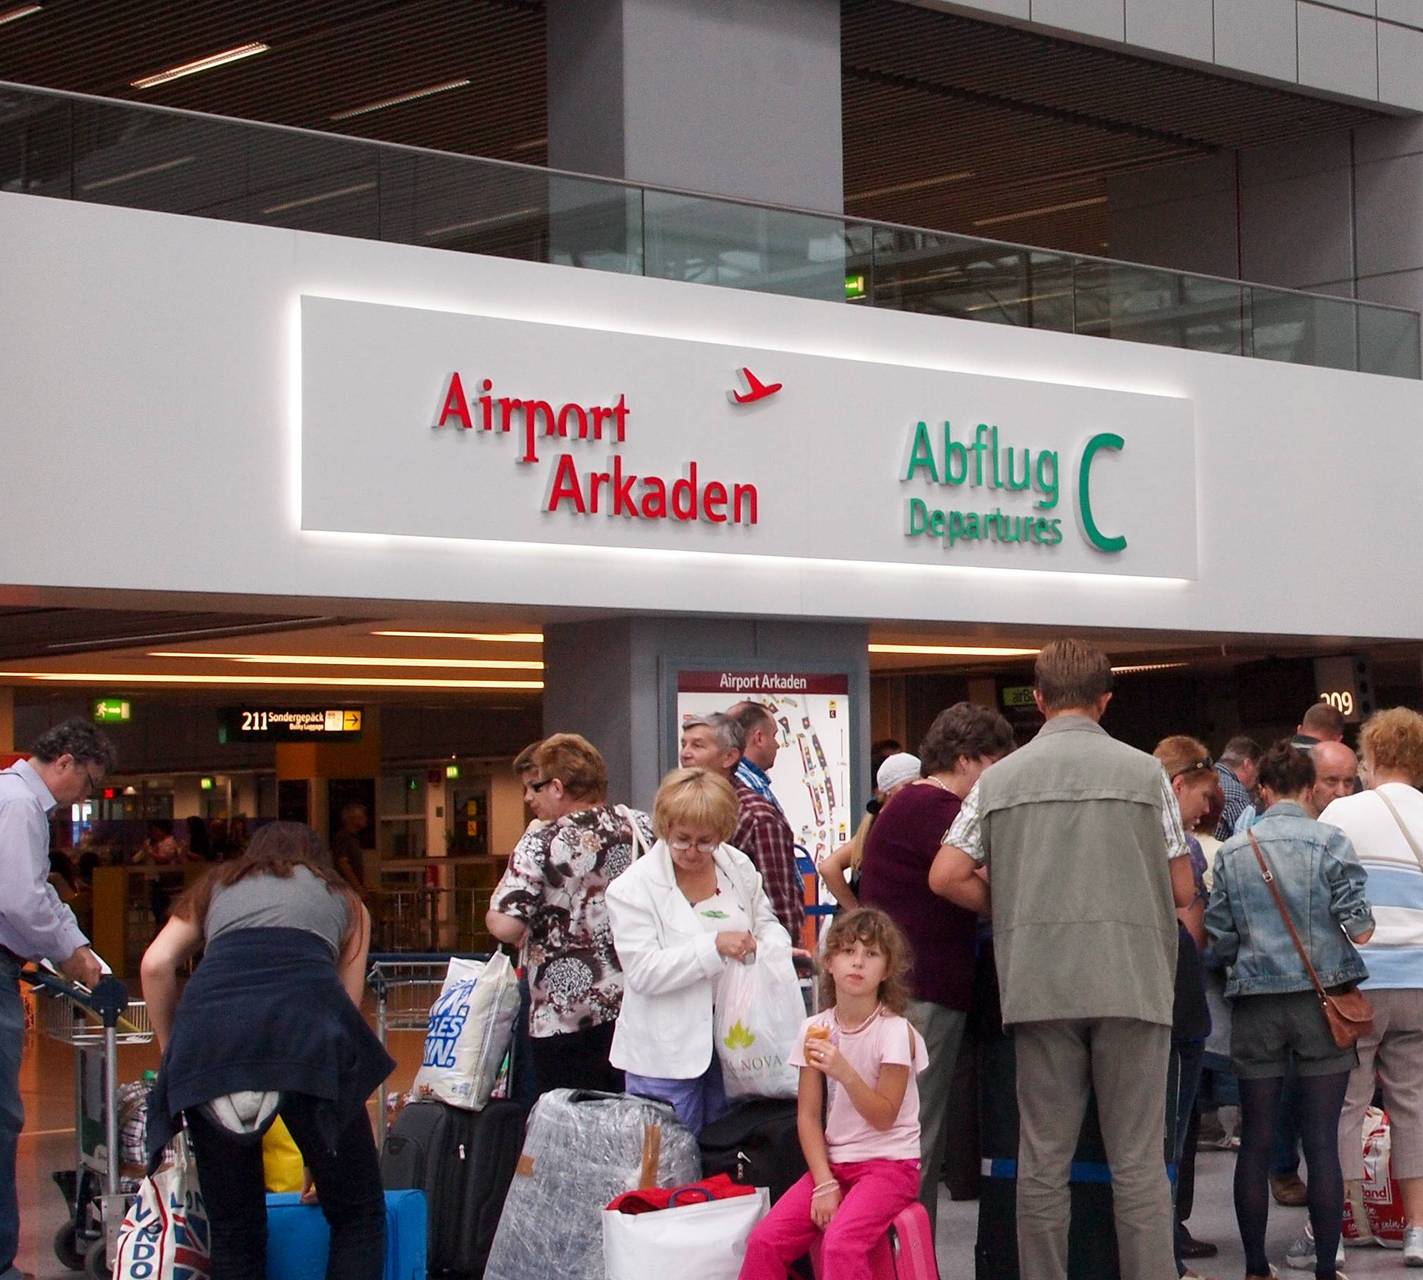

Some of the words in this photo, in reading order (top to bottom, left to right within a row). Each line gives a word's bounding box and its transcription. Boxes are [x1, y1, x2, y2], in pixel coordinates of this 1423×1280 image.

[436, 371, 630, 463] Airport
[545, 453, 758, 526] Arkaden
[904, 419, 1060, 508] Abflug
[1075, 432, 1128, 553] C
[907, 496, 1064, 548] Departures
[719, 672, 760, 691] Airport
[761, 673, 807, 690] Arkaden
[241, 711, 268, 731] 211
[268, 711, 324, 724] Sondergepäck
[741, 1053, 783, 1072] NOVA
